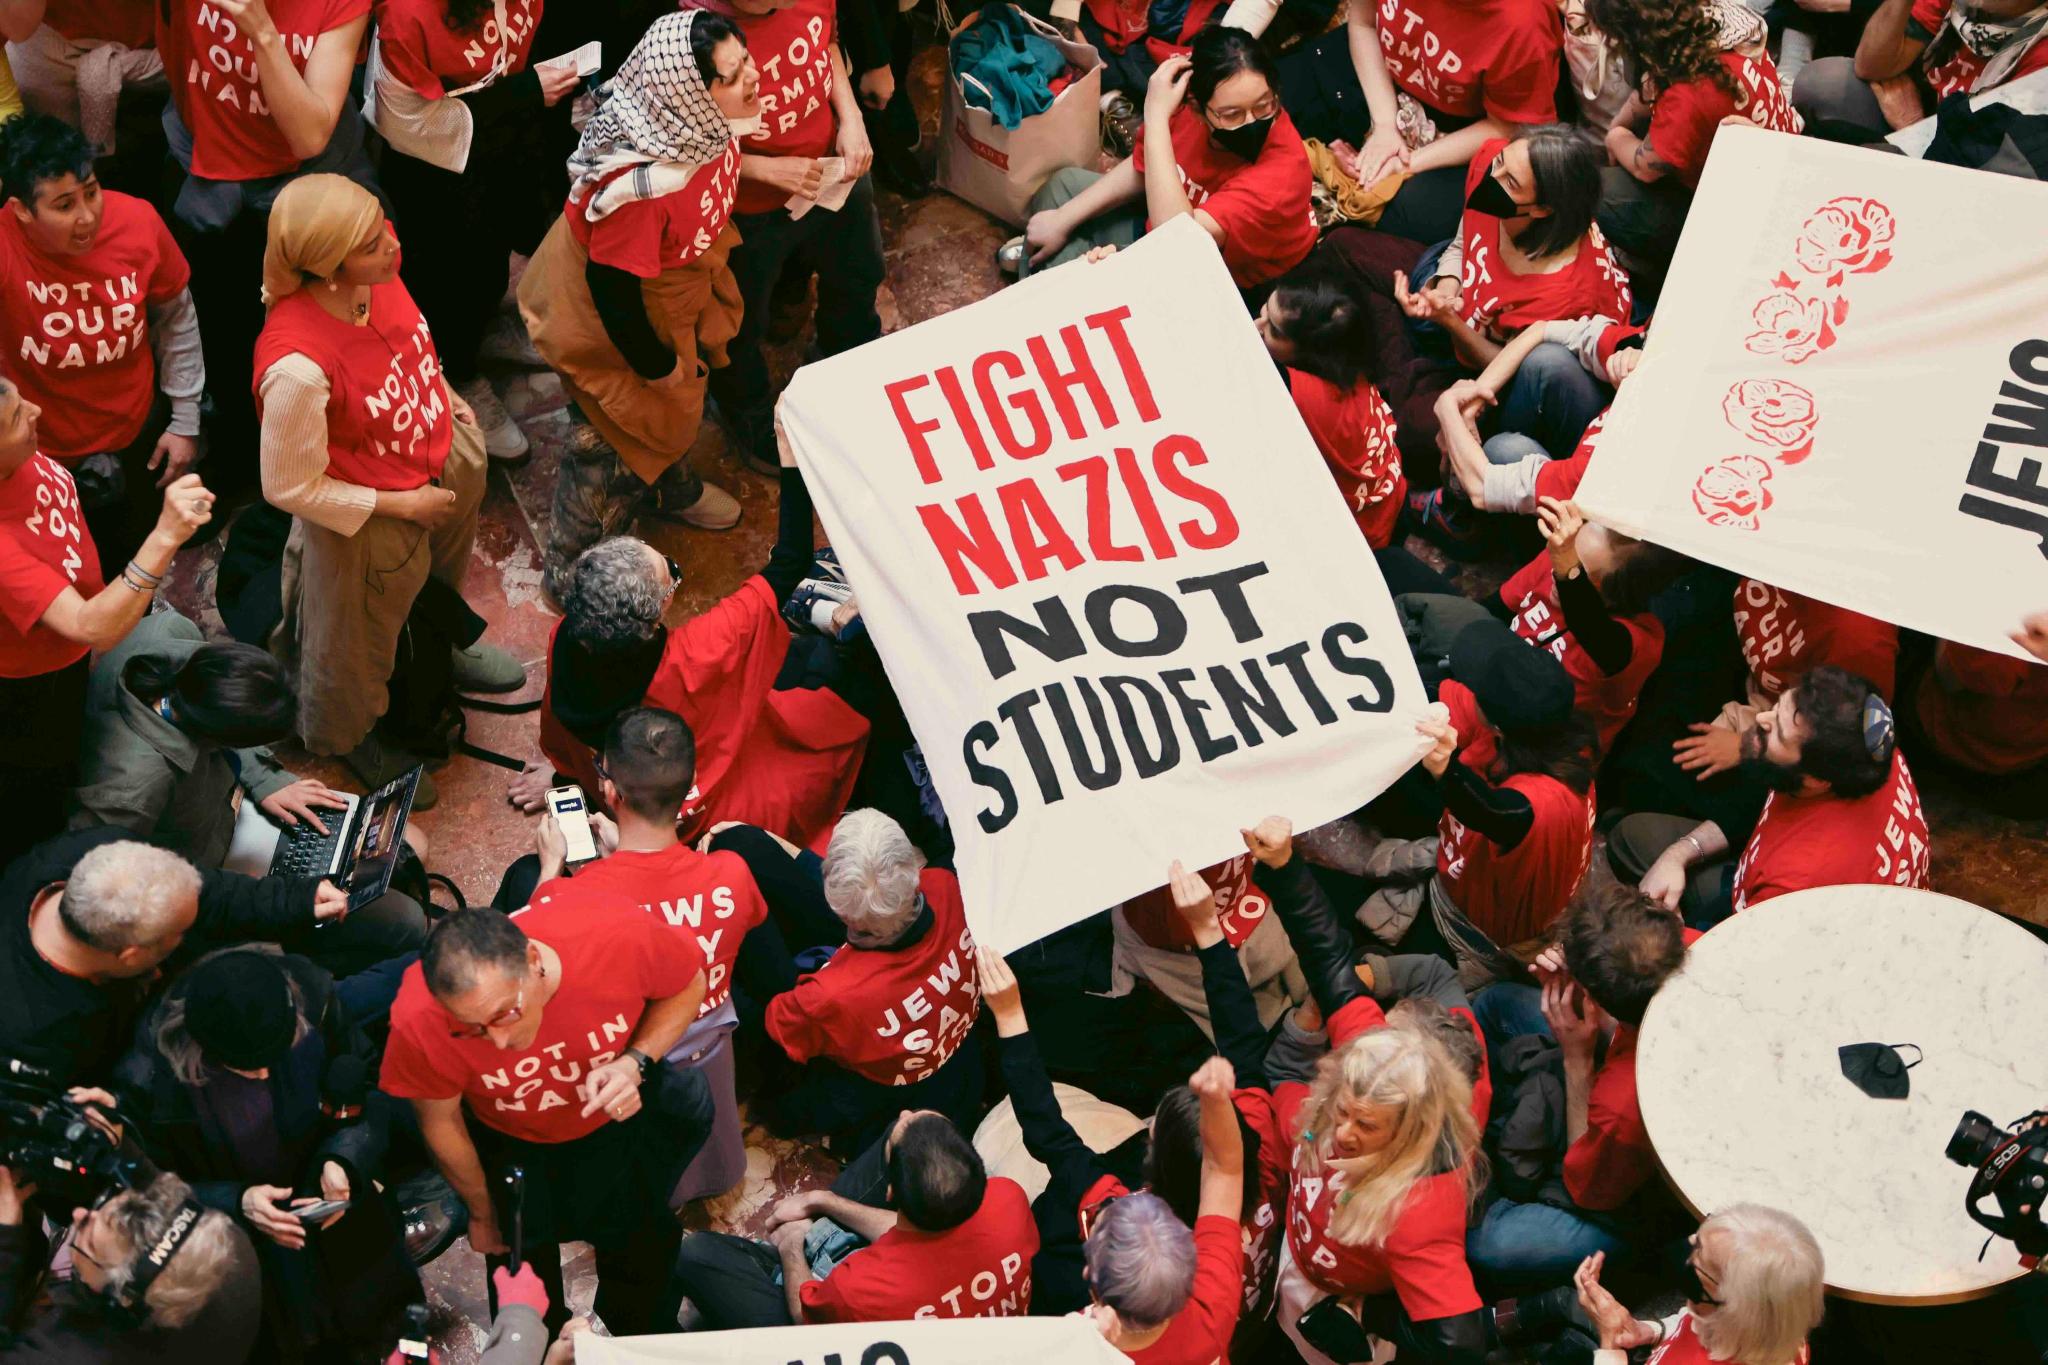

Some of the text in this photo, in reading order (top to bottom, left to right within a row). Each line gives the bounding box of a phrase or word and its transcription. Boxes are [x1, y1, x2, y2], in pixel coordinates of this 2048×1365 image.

[197, 2, 254, 51] NO
[463, 19, 500, 68] NO
[762, 16, 823, 82] TOP
[1382, 0, 1462, 73] STOP
[208, 44, 259, 84] OU
[755, 48, 834, 114] RMIN
[751, 71, 833, 141] SRAE
[26, 272, 137, 305] NOT IN
[43, 303, 135, 338] OUR
[21, 319, 144, 369] NAME
[365, 352, 404, 419] NOT
[393, 353, 438, 432] OUR
[884, 305, 1161, 485] FIGHT
[915, 434, 1240, 596] NAZIS
[967, 561, 1270, 680] NOT
[1734, 586, 1782, 694] AME
[963, 622, 1396, 834] STUDENTS
[1876, 754, 1913, 878] JEWS
[638, 886, 735, 927] WS
[877, 927, 977, 1037] JEWS
[903, 965, 976, 1055] SAY
[480, 1013, 629, 1090] NOT IN
[495, 1083, 588, 1112] NA
[1994, 1143, 2021, 1169] EOS
[148, 1207, 197, 1266] TASCAM
